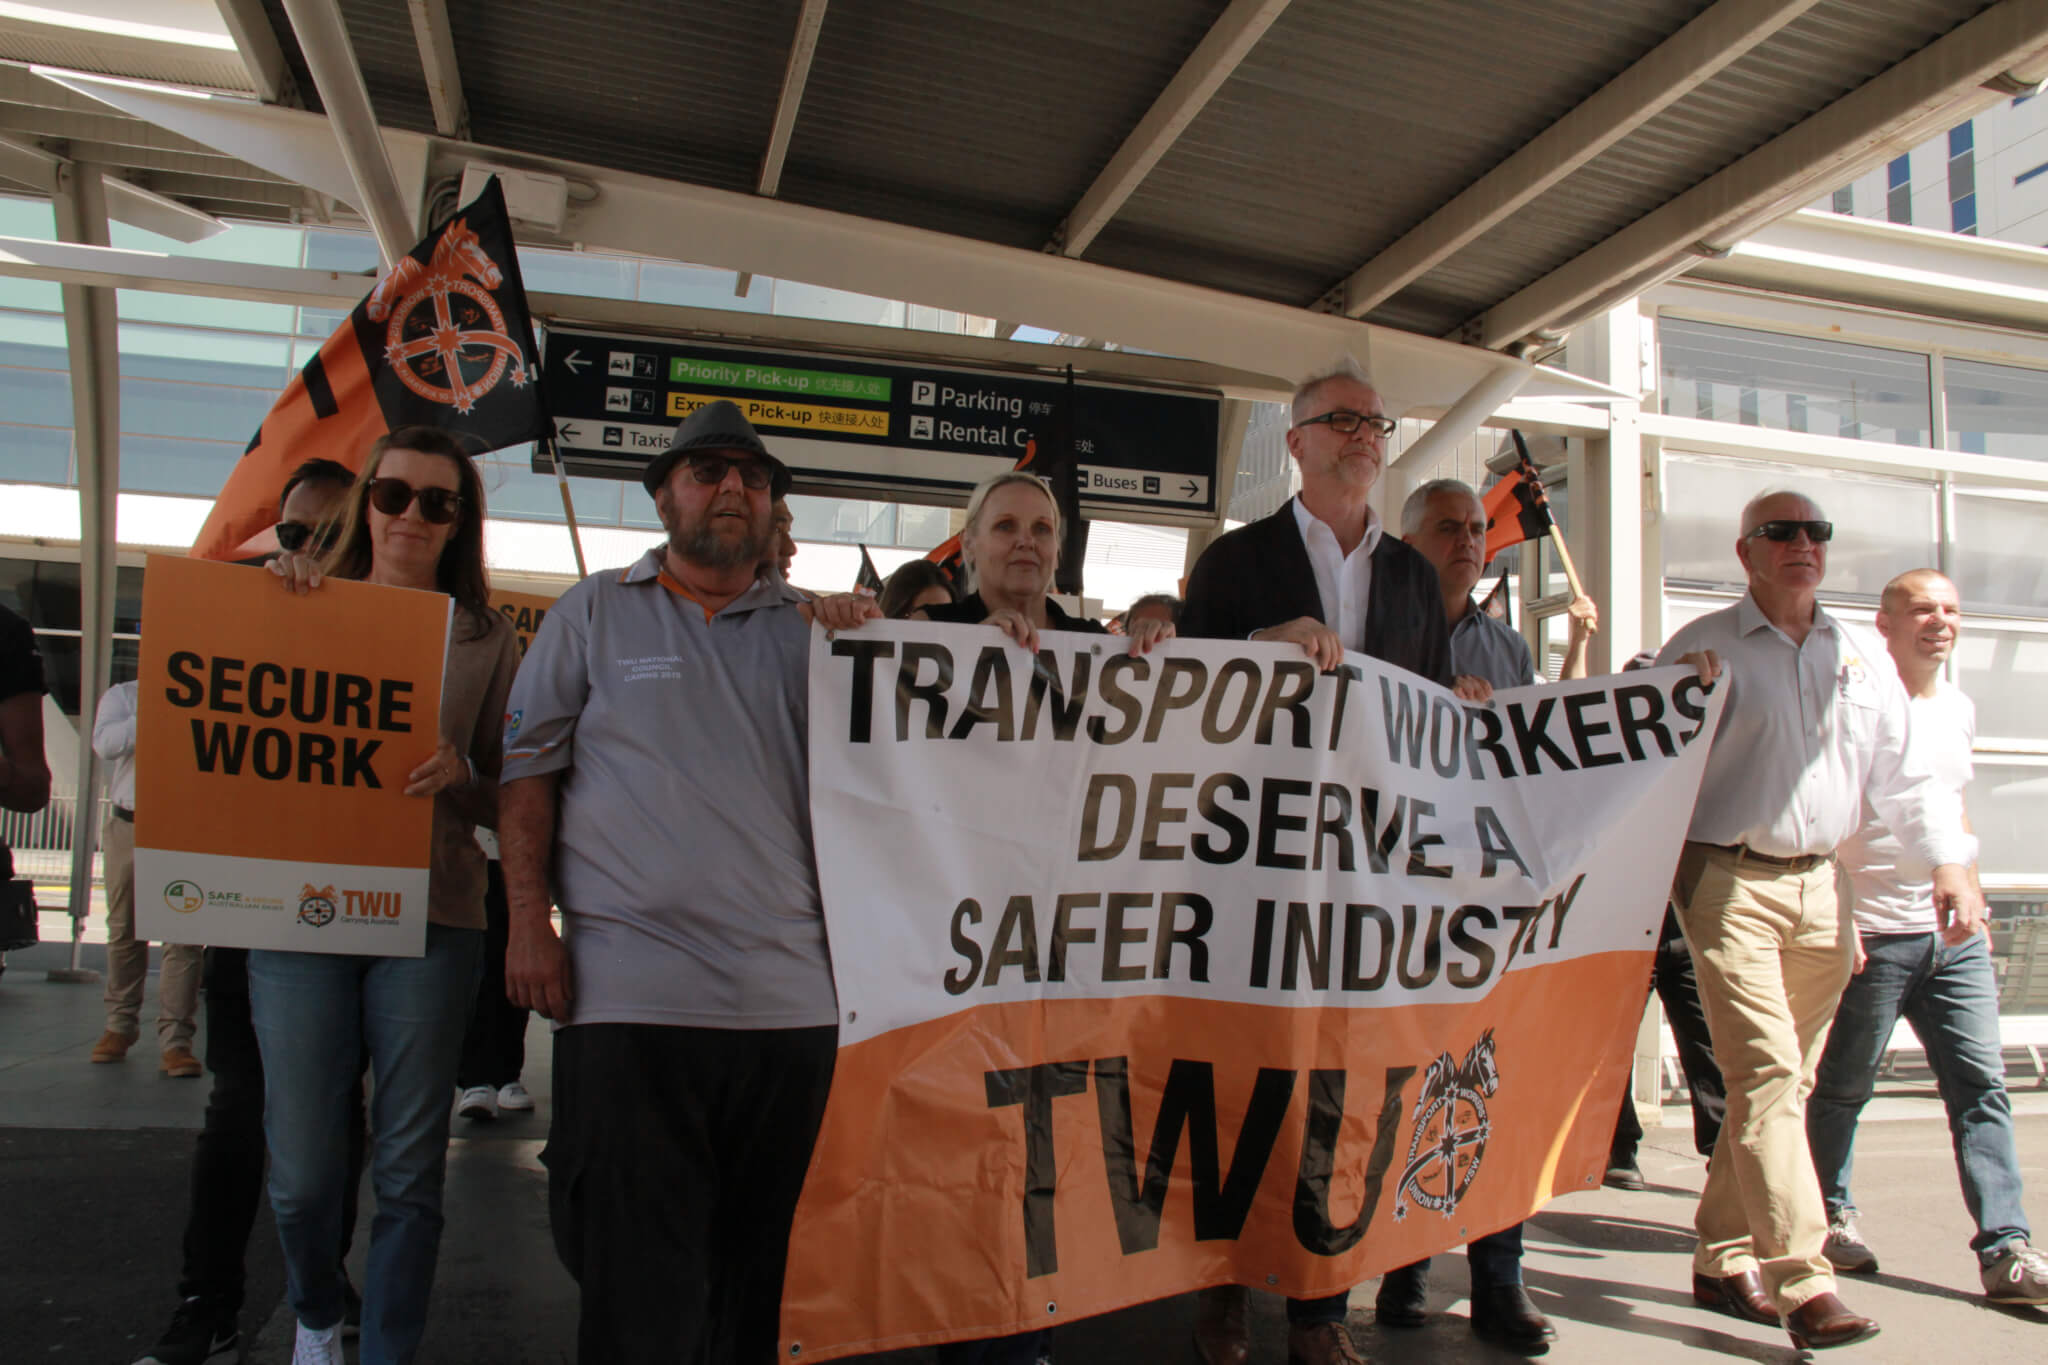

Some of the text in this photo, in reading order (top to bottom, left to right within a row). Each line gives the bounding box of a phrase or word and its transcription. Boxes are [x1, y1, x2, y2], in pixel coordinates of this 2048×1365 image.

[677, 361, 809, 391] Priority Pick-up
[749, 403, 812, 424] Pick-up
[941, 387, 1023, 418] Parking
[629, 431, 672, 449] Taxis
[939, 420, 1007, 446] Rental
[1093, 473, 1138, 490] Buses
[165, 650, 414, 734] SECURE
[831, 638, 1716, 780] TRANSPORT WORKERS
[190, 719, 383, 789] WORK
[1078, 772, 1532, 879] DESERVE A
[208, 891, 241, 902] SAFE
[342, 890, 402, 918] TWU
[943, 892, 1214, 996] SAFER
[1408, 1097, 1443, 1163] TRANSPORT
[984, 1055, 1416, 1280] TWU
[1463, 1157, 1481, 1186] NSW
[1408, 1179, 1433, 1209] UNION
